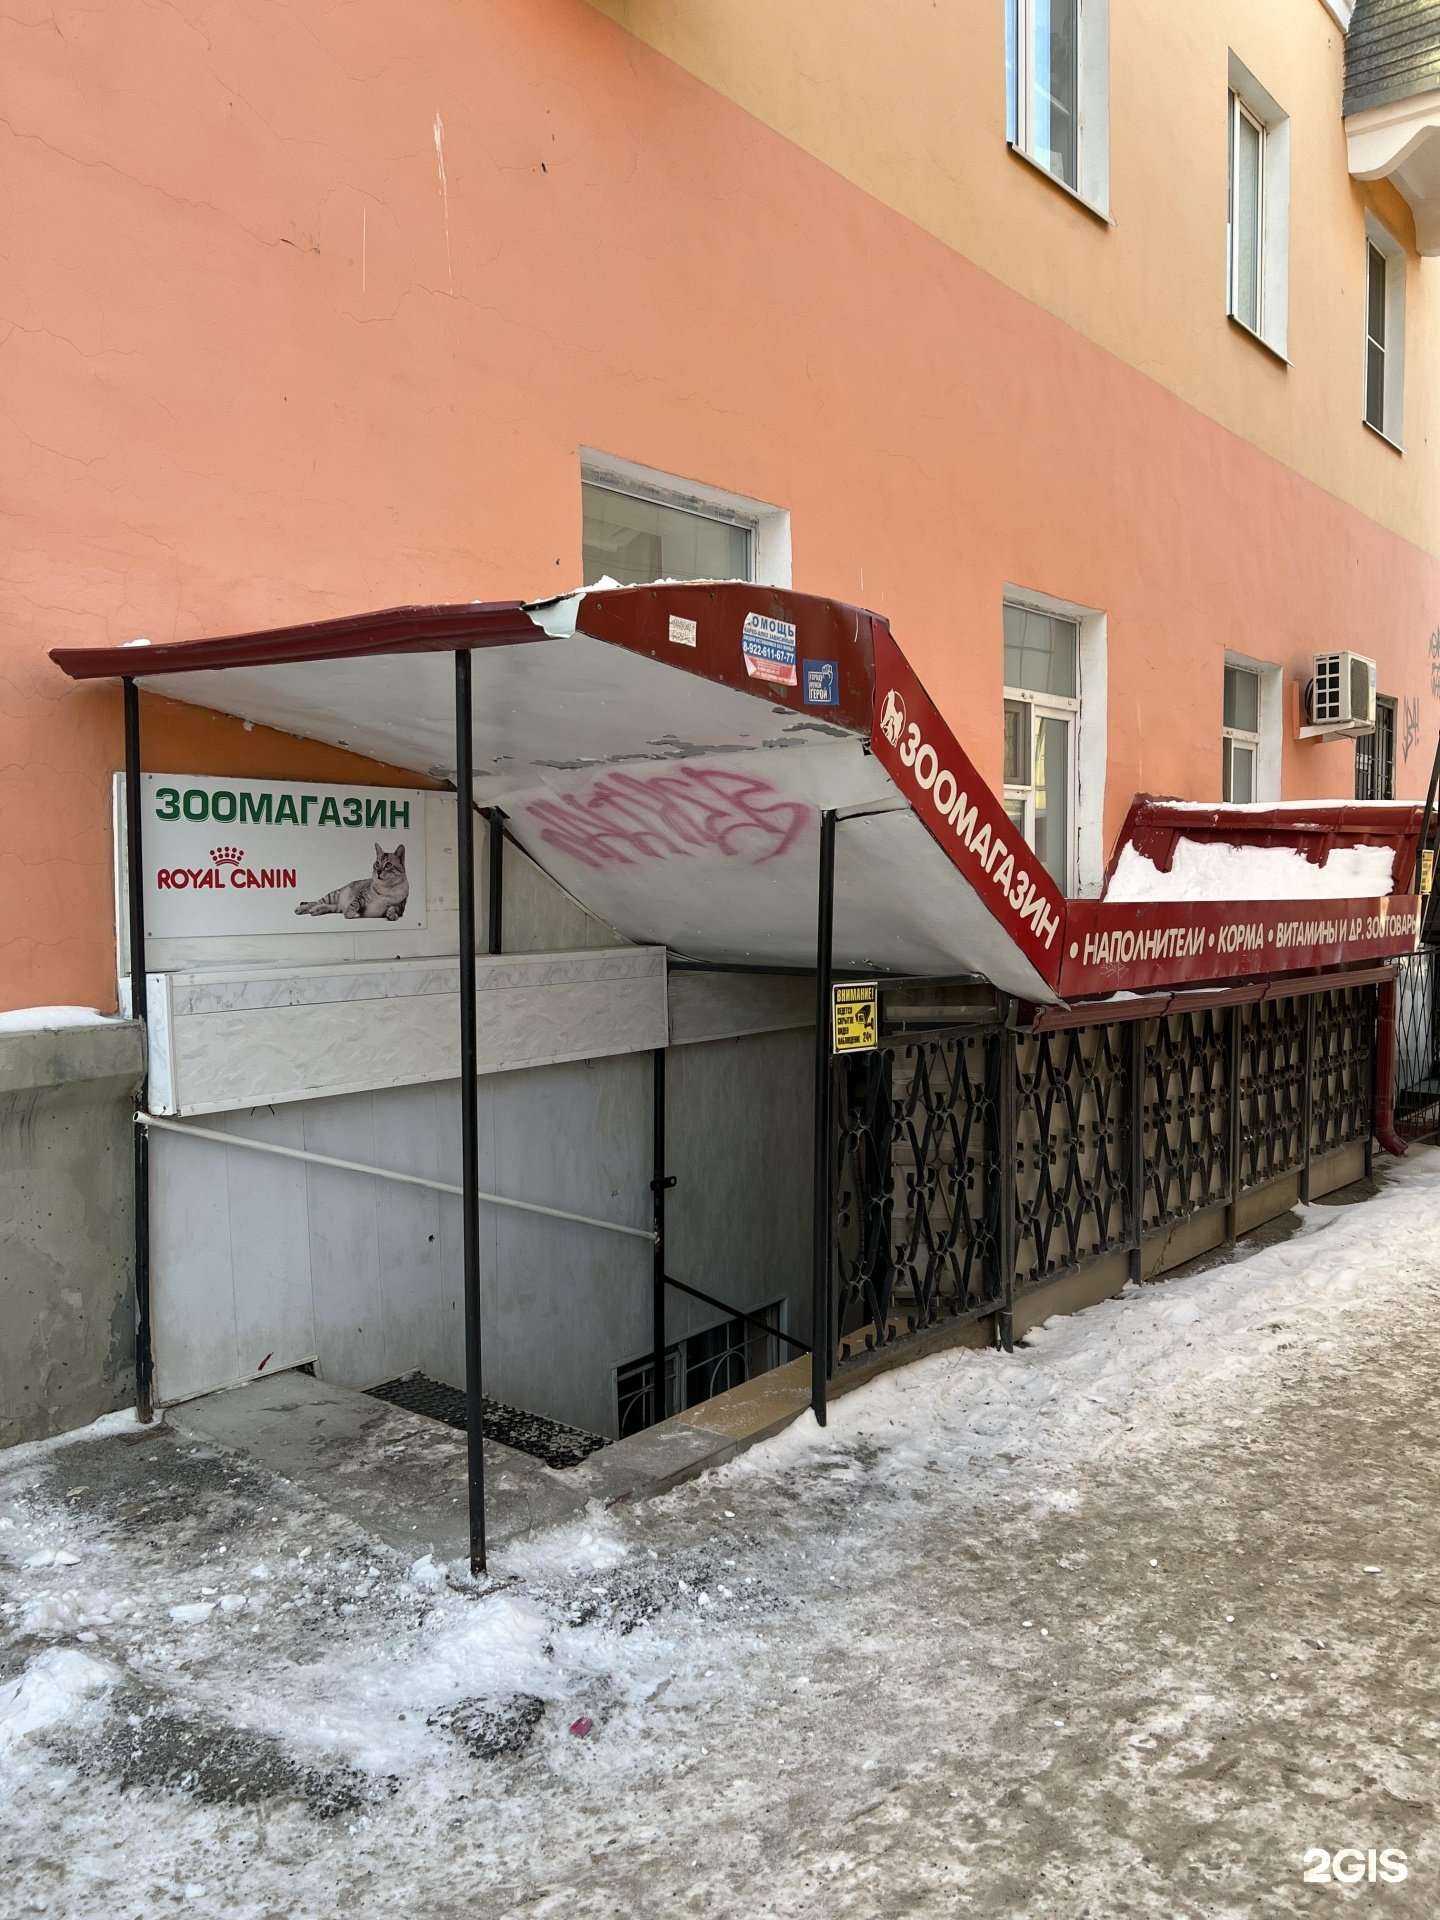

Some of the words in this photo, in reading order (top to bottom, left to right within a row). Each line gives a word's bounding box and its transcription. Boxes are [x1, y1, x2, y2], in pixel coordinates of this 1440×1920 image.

[746, 616, 794, 637] ОМОЩЬ
[743, 641, 794, 663] 8-922-611-67-77
[810, 688, 828, 700] ГЕРОЙ
[155, 787, 410, 829] ЗООМАГАЗИН
[900, 722, 1060, 949] ЗООМАГАЗИН
[157, 868, 225, 890] ROYAL
[230, 868, 297, 889] CANIN
[1083, 926, 1206, 966] НАПОЛНИТЕЛИ
[1217, 922, 1264, 954] КОРМА
[1275, 919, 1338, 949] ВИТАМИНЫ
[1339, 918, 1349, 943] И
[1348, 917, 1365, 942] ДР.
[836, 987, 874, 1002] ВНИМАНИЕ!
